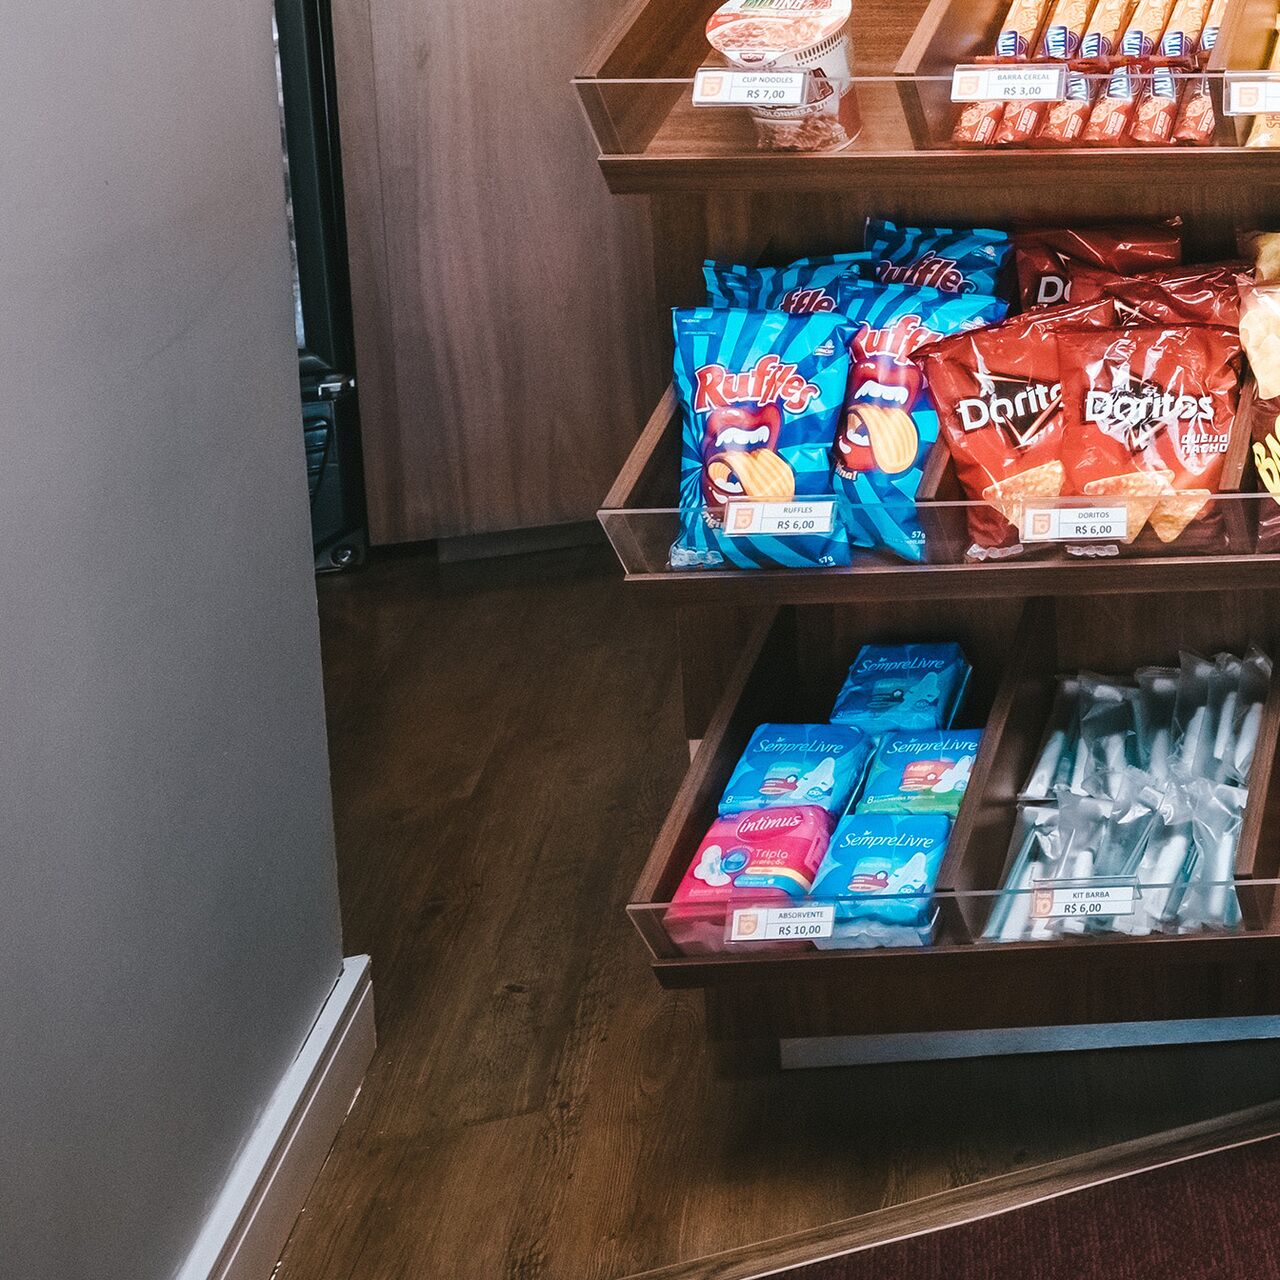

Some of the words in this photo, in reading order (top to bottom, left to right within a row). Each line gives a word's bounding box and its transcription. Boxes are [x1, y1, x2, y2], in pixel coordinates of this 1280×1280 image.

[746, 89, 759, 99] R$
[761, 89, 784, 100] 7,00
[1004, 87, 1017, 96] R$
[1020, 86, 1041, 96] 3,00
[694, 354, 823, 414] Ruffles
[1085, 391, 1214, 423] Doritos
[1181, 434, 1229, 444] QUEIJO
[1078, 511, 1110, 519] DORITOS
[777, 521, 791, 530] R$
[792, 520, 814, 530] 6,00
[1075, 526, 1088, 535] R$
[1090, 525, 1112, 535] 6,00
[741, 814, 801, 833] intimus
[756, 849, 788, 860] Tripla
[1064, 904, 1076, 914] R$
[1080, 903, 1102, 913] 6,00
[778, 911, 823, 919] ABSORVENTE
[779, 925, 791, 936] R$
[793, 925, 821, 936] 10,00
